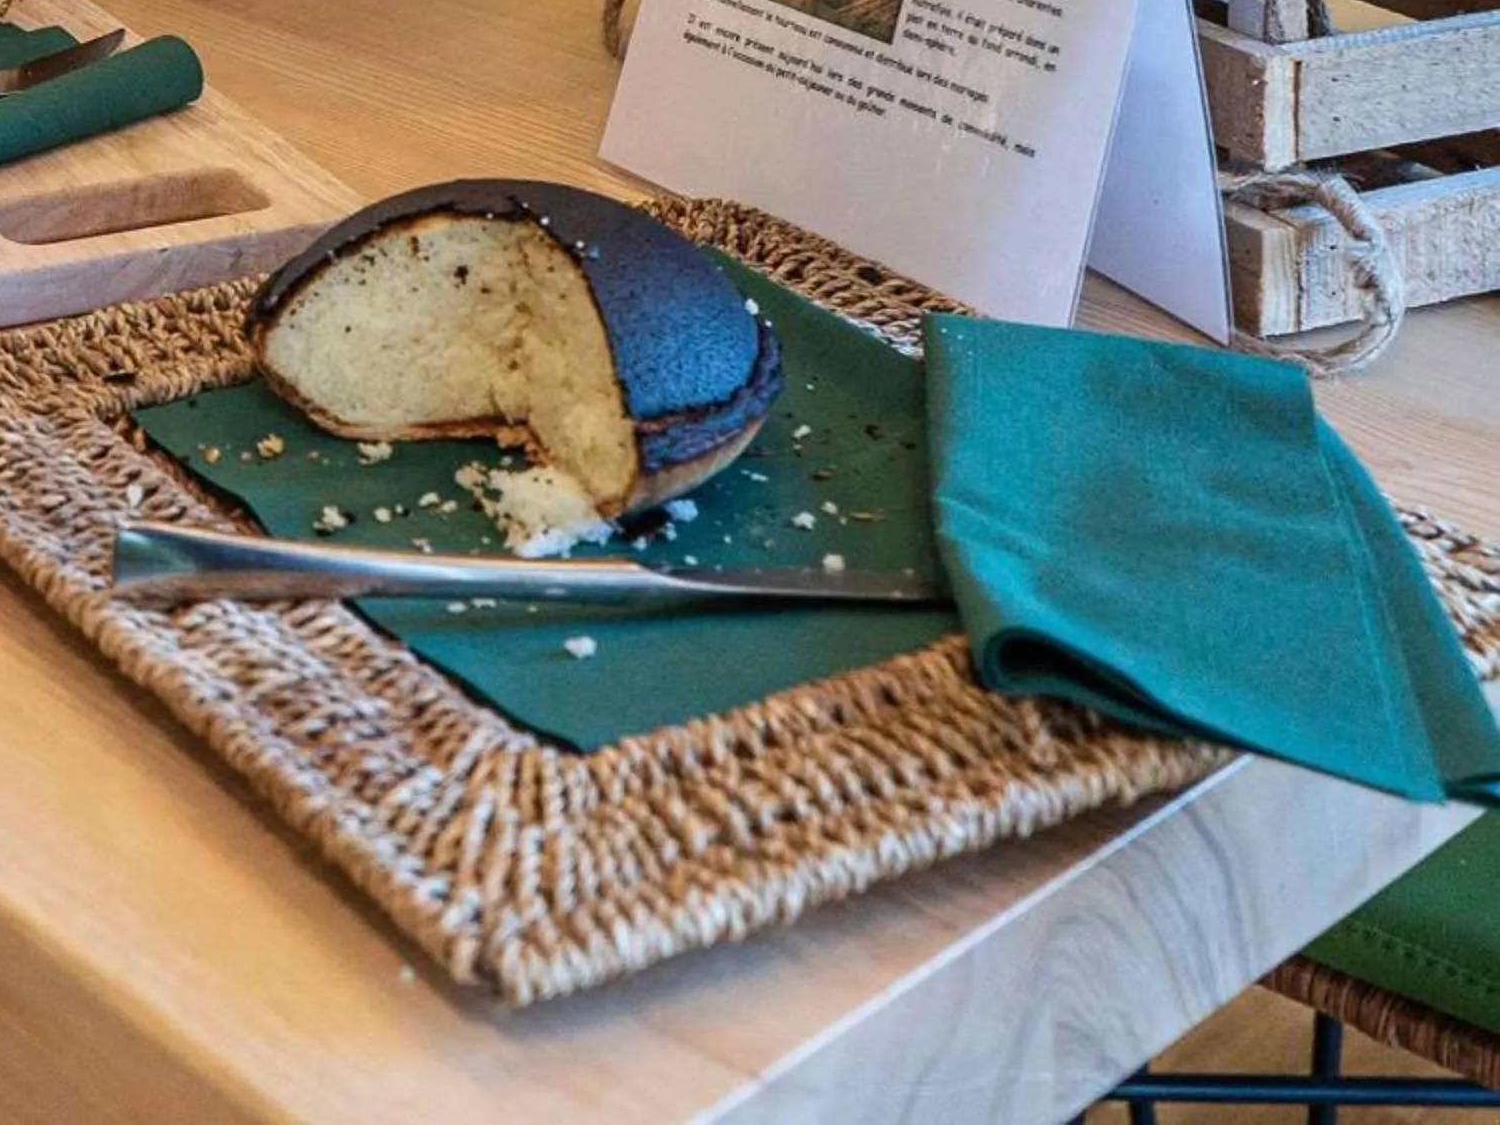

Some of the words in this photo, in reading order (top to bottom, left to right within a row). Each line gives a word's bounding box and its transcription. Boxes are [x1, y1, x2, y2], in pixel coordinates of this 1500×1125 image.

[698, 20, 712, 30] est
[715, 27, 741, 43] encore
[847, 77, 863, 90] des
[808, 29, 823, 40] est
[933, 74, 949, 88] des
[981, 38, 1003, 54] fond
